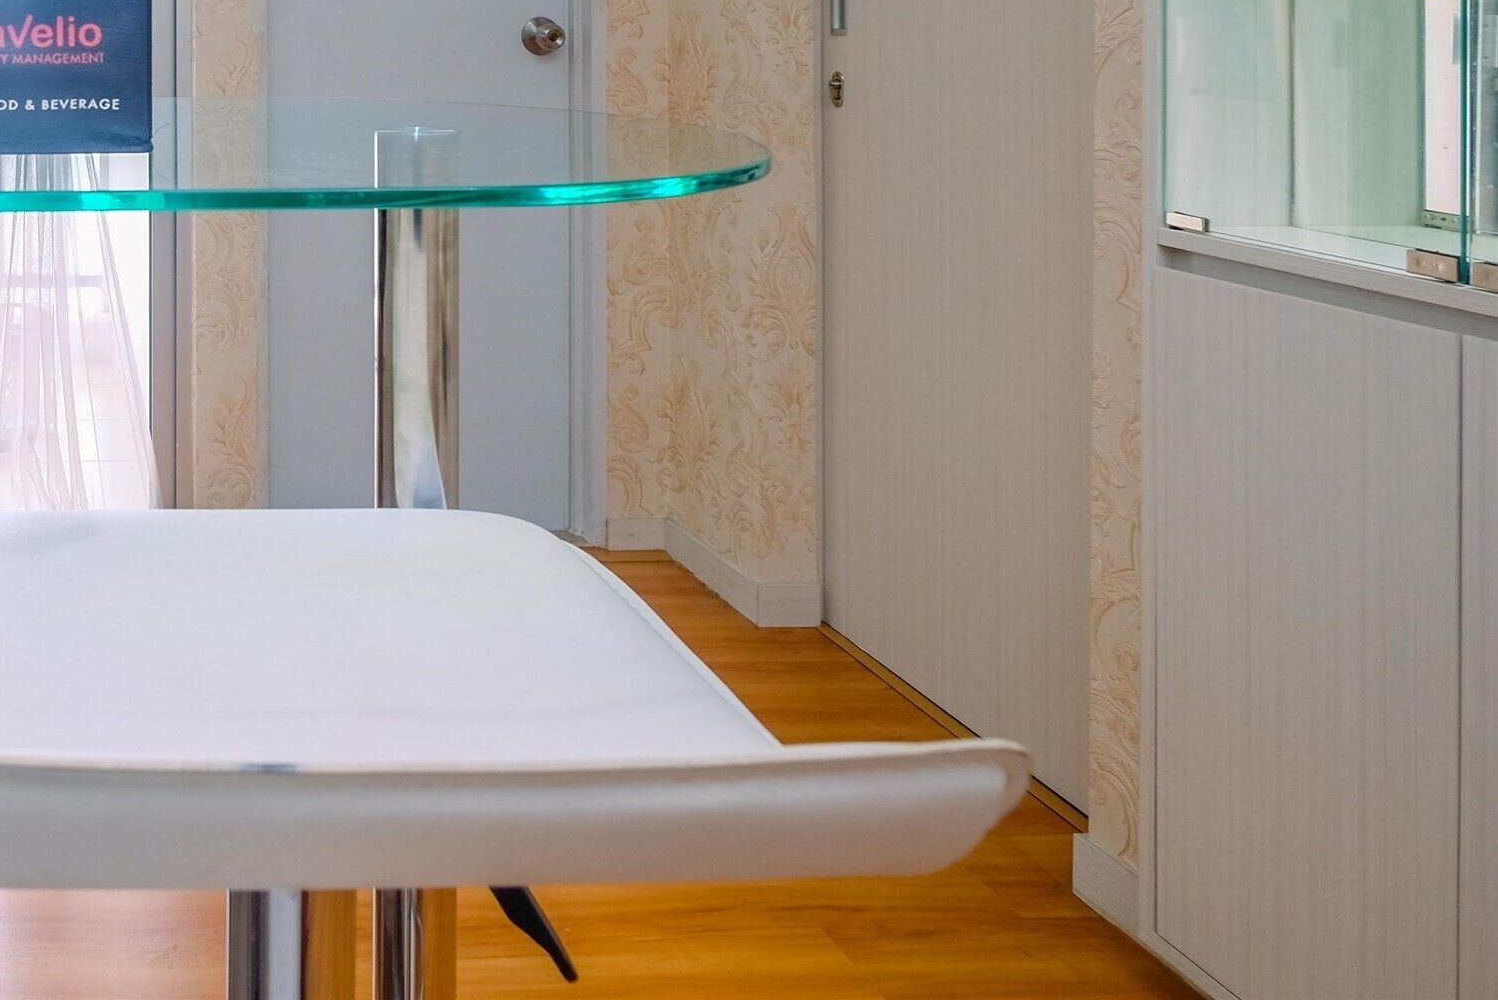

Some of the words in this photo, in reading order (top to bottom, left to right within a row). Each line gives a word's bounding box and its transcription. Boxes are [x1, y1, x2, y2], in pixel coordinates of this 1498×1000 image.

[12, 52, 105, 65] MANAGEMENT
[24, 99, 36, 111] &
[41, 98, 120, 111] BEVERAGE
